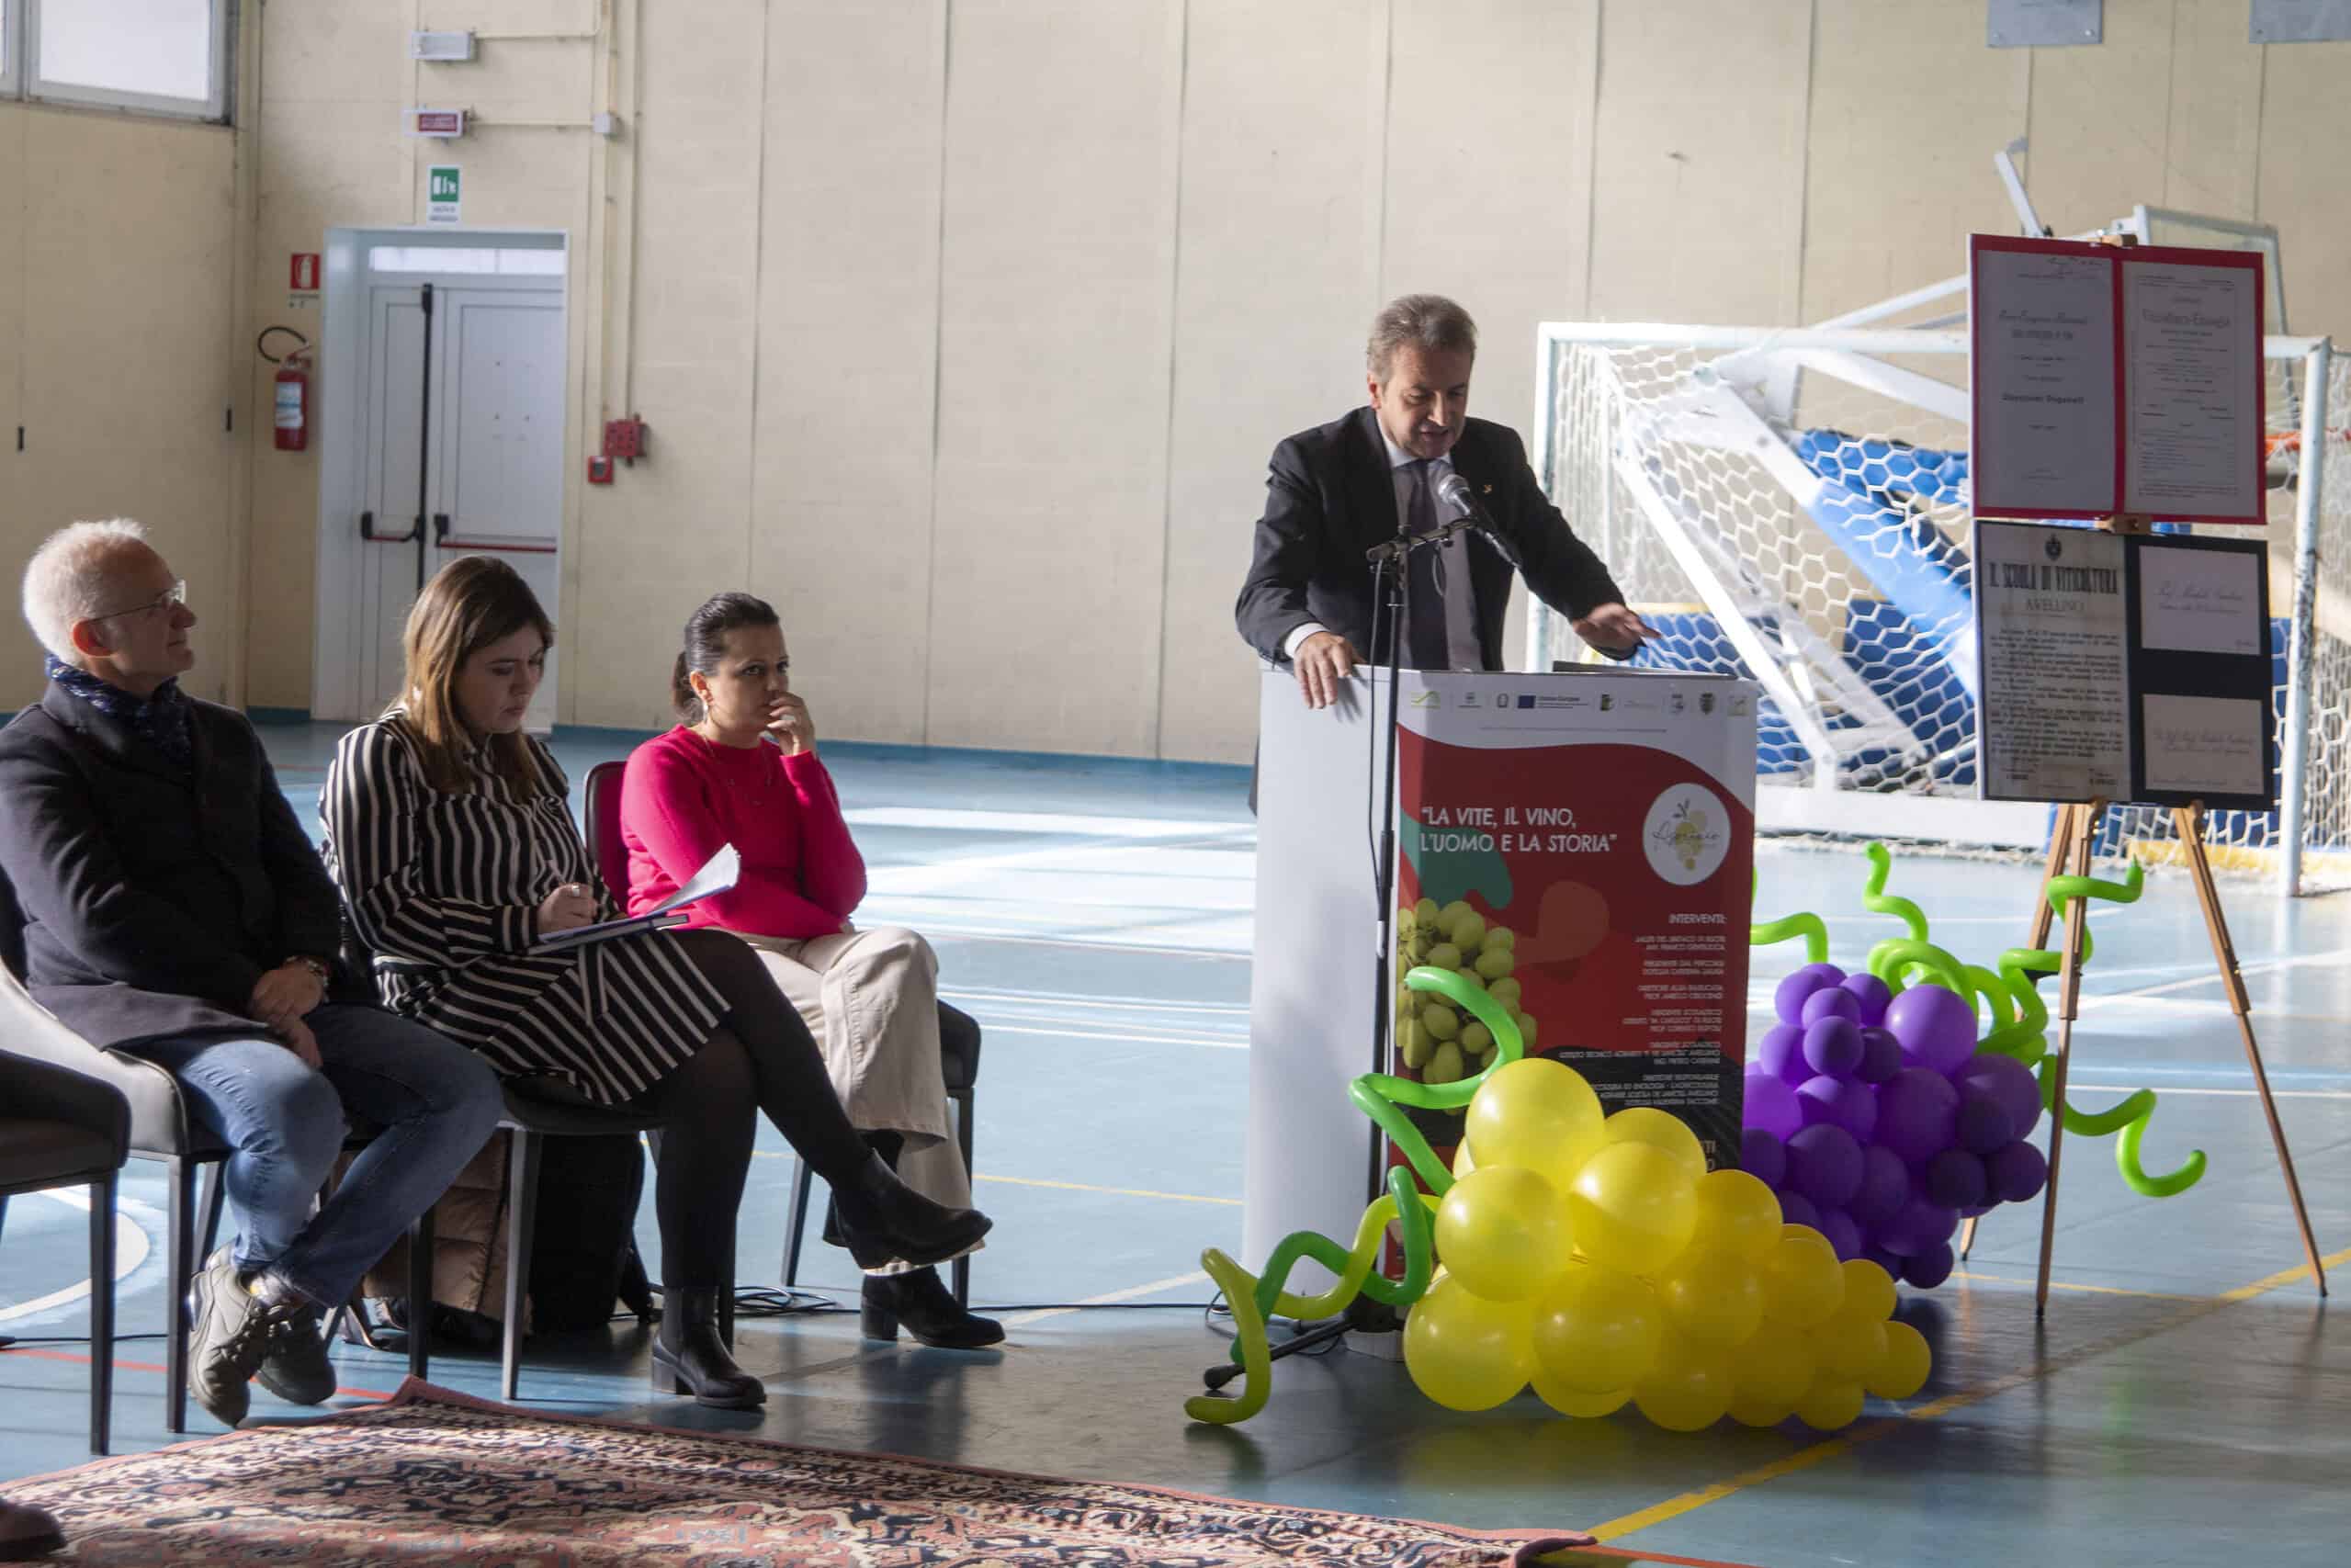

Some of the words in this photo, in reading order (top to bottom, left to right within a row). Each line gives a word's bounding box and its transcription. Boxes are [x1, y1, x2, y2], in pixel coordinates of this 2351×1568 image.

[1456, 807, 1498, 829] VITE,
[1504, 807, 1520, 825] IL
[1525, 807, 1577, 829] VINO,
[1420, 833, 1494, 852] L'UOMO
[1501, 834, 1512, 852] E
[1519, 833, 1542, 852] LA
[1547, 833, 1618, 852] STORIA"
